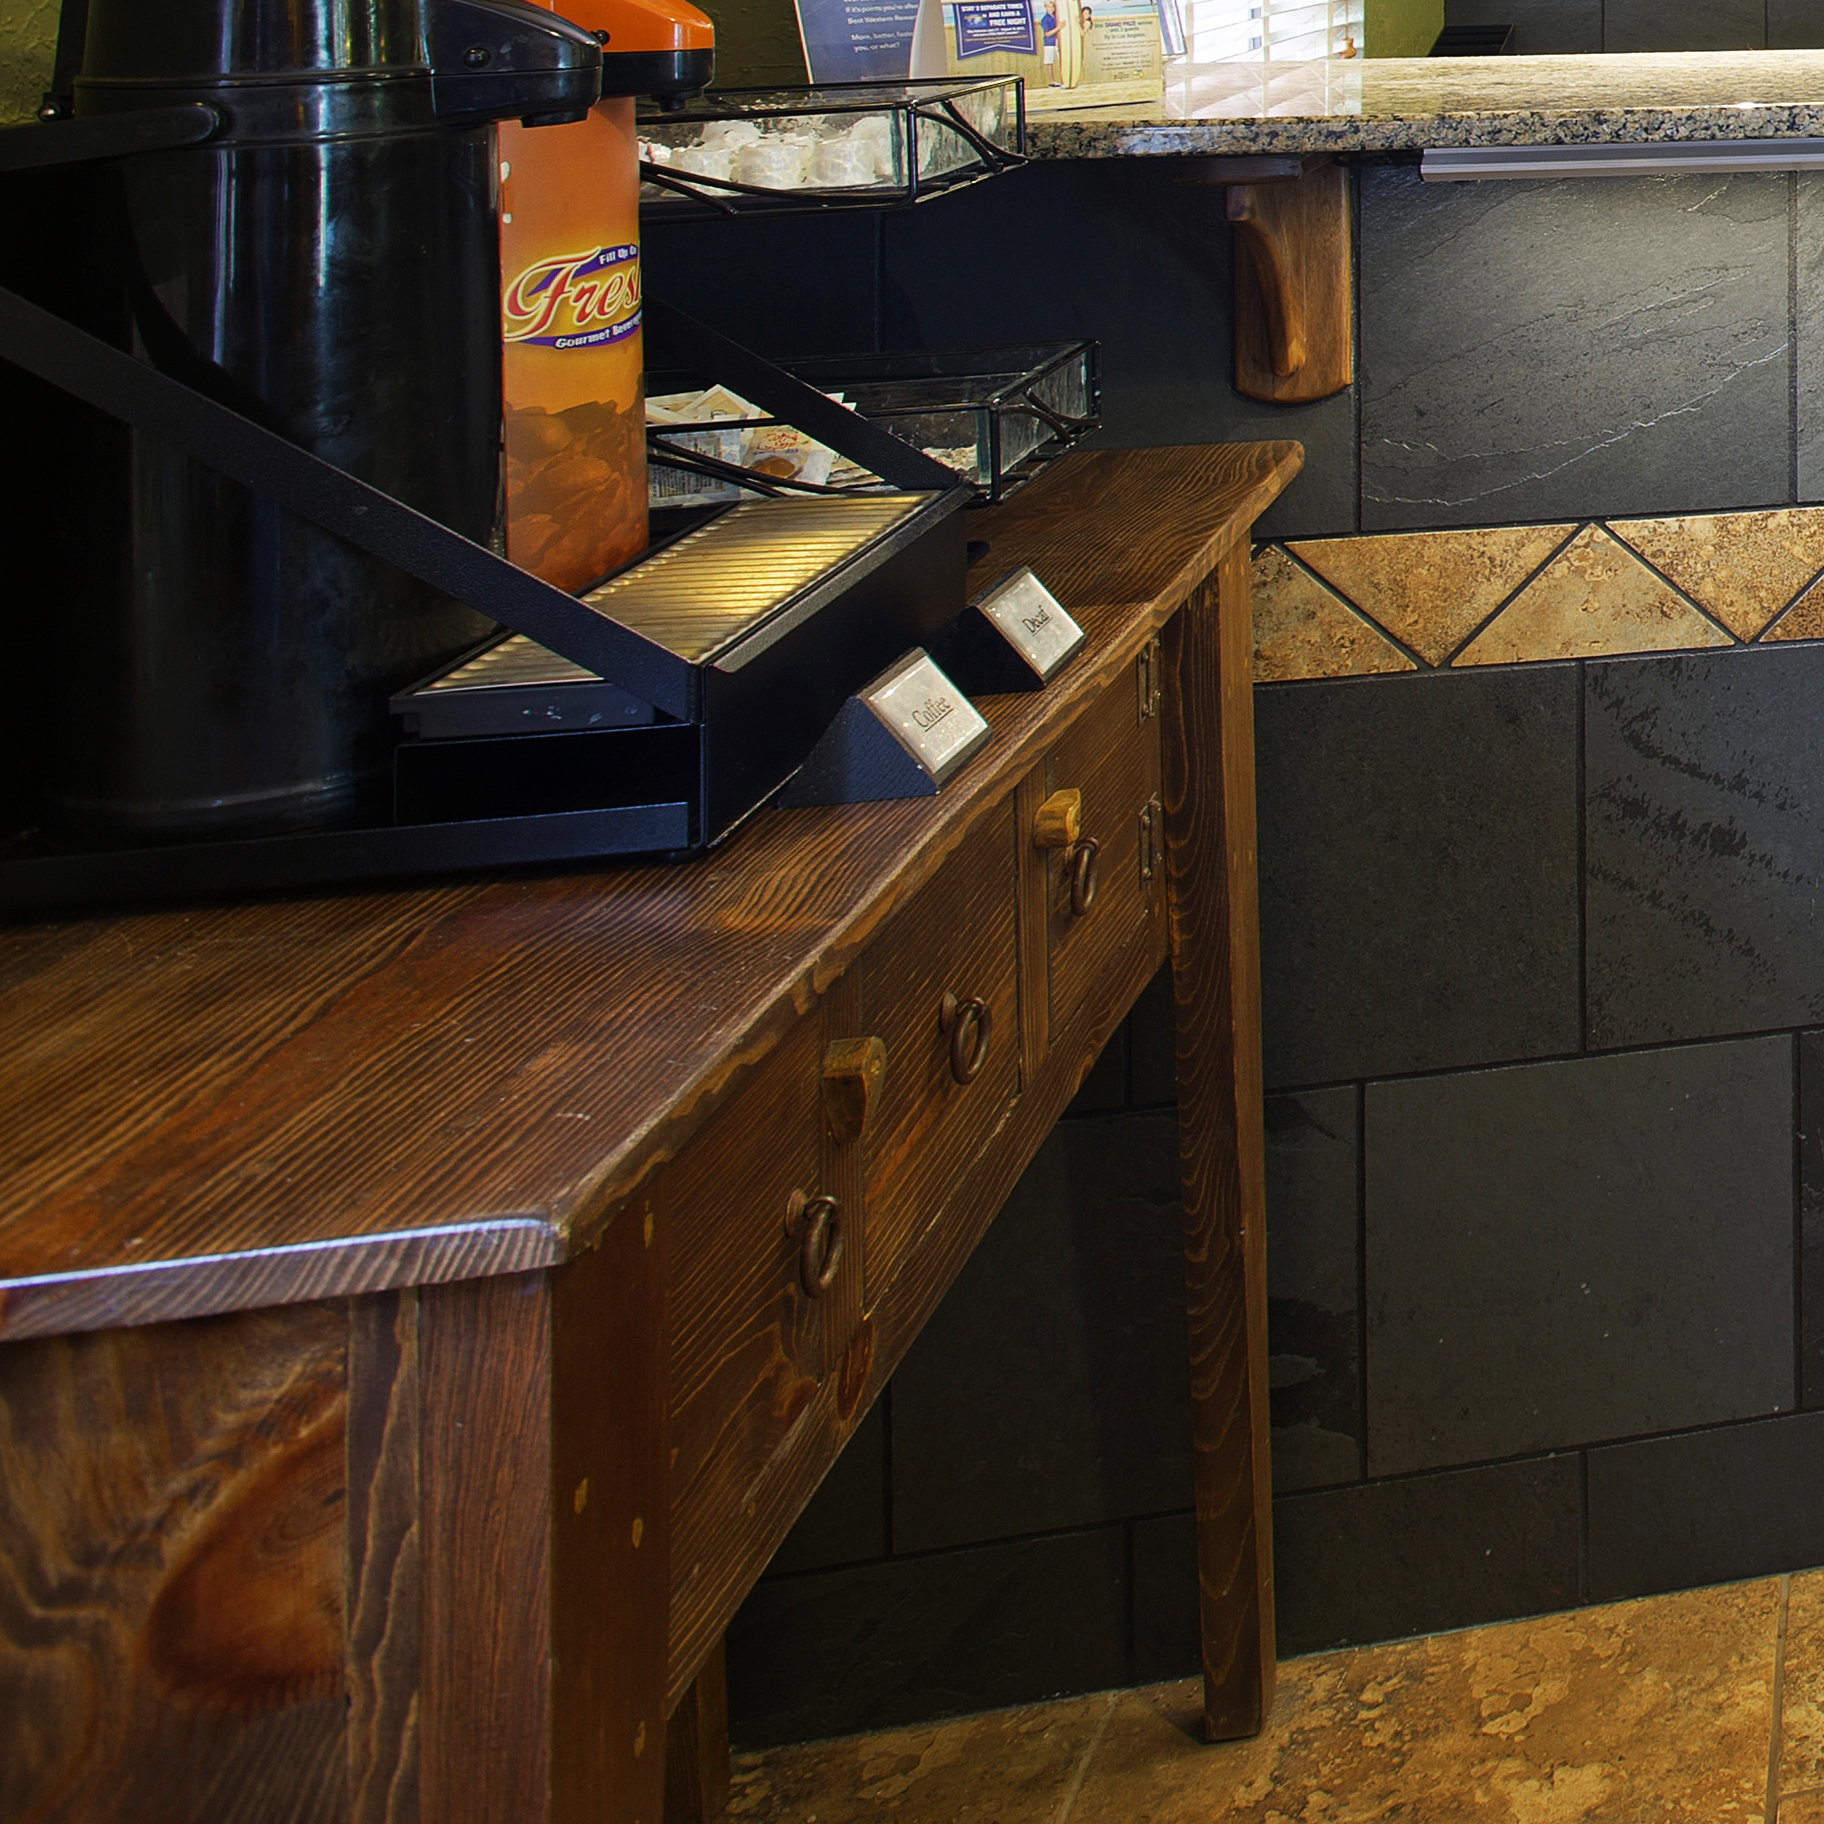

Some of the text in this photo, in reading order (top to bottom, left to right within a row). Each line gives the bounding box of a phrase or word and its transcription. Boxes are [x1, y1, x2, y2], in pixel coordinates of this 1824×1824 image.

[599, 251, 616, 265] Fill
[618, 248, 628, 259] Up
[556, 329, 610, 348] Gourmet
[1022, 605, 1050, 633] Decaf
[912, 698, 951, 728] Coffee
